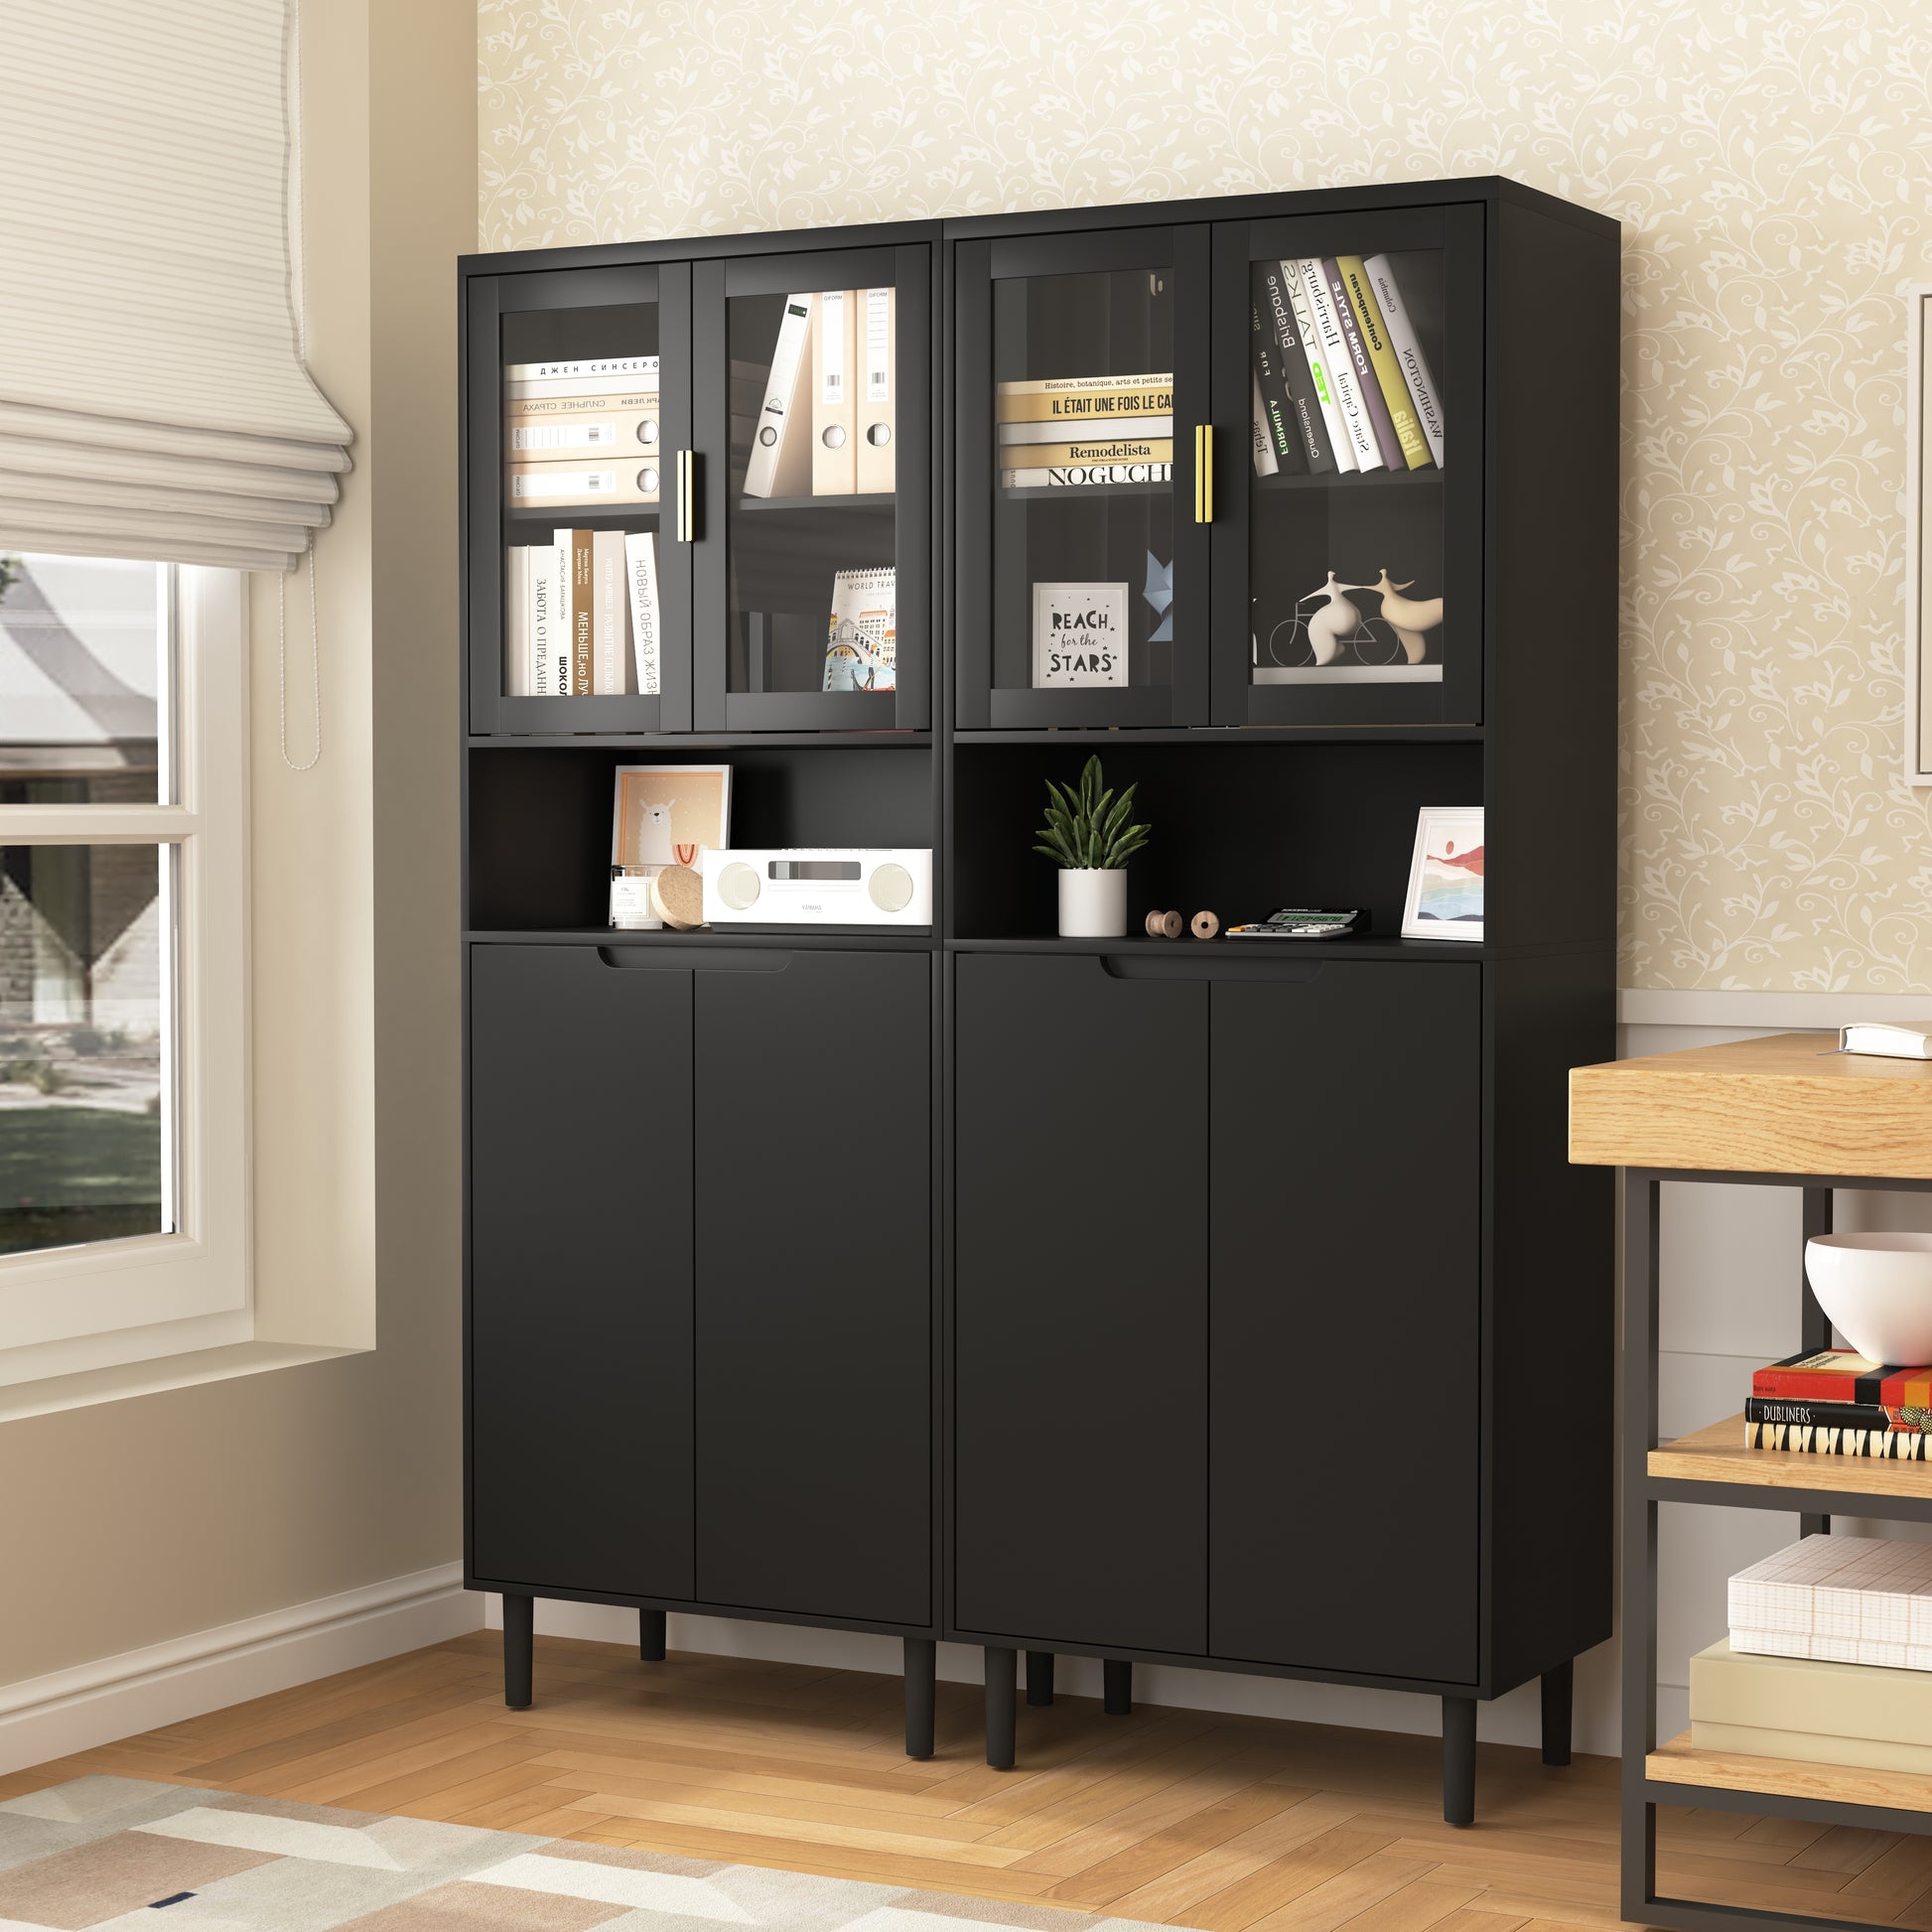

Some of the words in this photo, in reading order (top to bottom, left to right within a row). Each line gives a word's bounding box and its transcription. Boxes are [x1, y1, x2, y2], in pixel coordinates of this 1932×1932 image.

[540, 365, 579, 375] ДЖЕН
[591, 360, 659, 372] СИНСЕРО
[1077, 378, 1114, 388] botanique,
[1142, 376, 1163, 385] petits
[1052, 399, 1062, 415] IL
[1064, 396, 1092, 414] ÉTAIT
[1094, 397, 1115, 412] UNE
[1117, 395, 1141, 411] FOIS
[1143, 395, 1155, 409] LE
[1157, 394, 1173, 409] CA
[1069, 444, 1152, 459] Remodelista
[635, 559, 652, 609] НОВЫЙ
[536, 579, 547, 622] ЗАБОТА
[1051, 610, 1108, 630] REACH
[537, 626, 547, 635] О
[639, 613, 654, 655] ОБРАЗ
[1060, 633, 1078, 648] for
[1079, 632, 1098, 646] the
[1050, 653, 1112, 673] STARS
[1763, 1405, 1811, 1424] DUBLINERS
